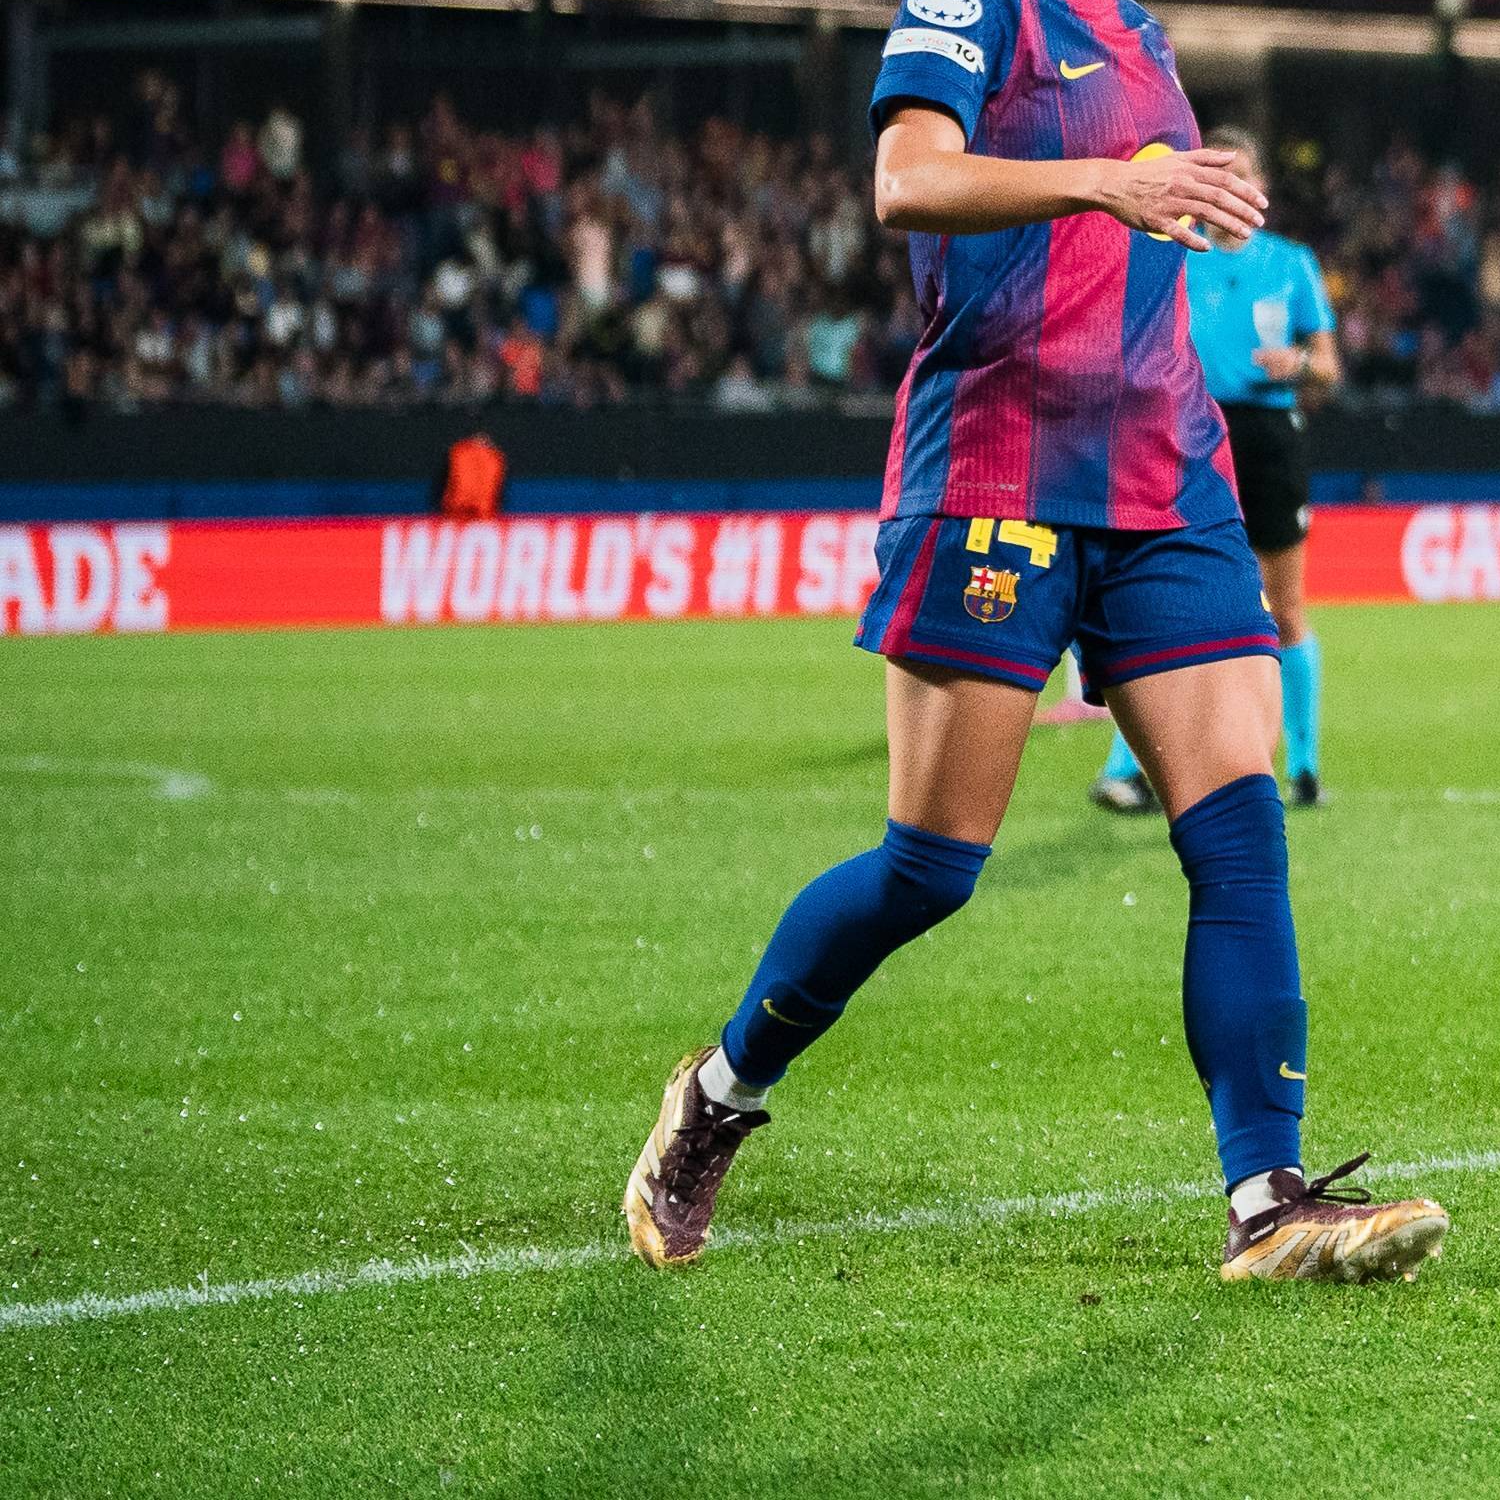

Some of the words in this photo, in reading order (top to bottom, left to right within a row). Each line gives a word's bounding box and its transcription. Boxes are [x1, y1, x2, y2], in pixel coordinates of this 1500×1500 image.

[381, 512, 692, 622] WORLD'S
[708, 516, 780, 616] #1
[796, 514, 881, 613] SP
